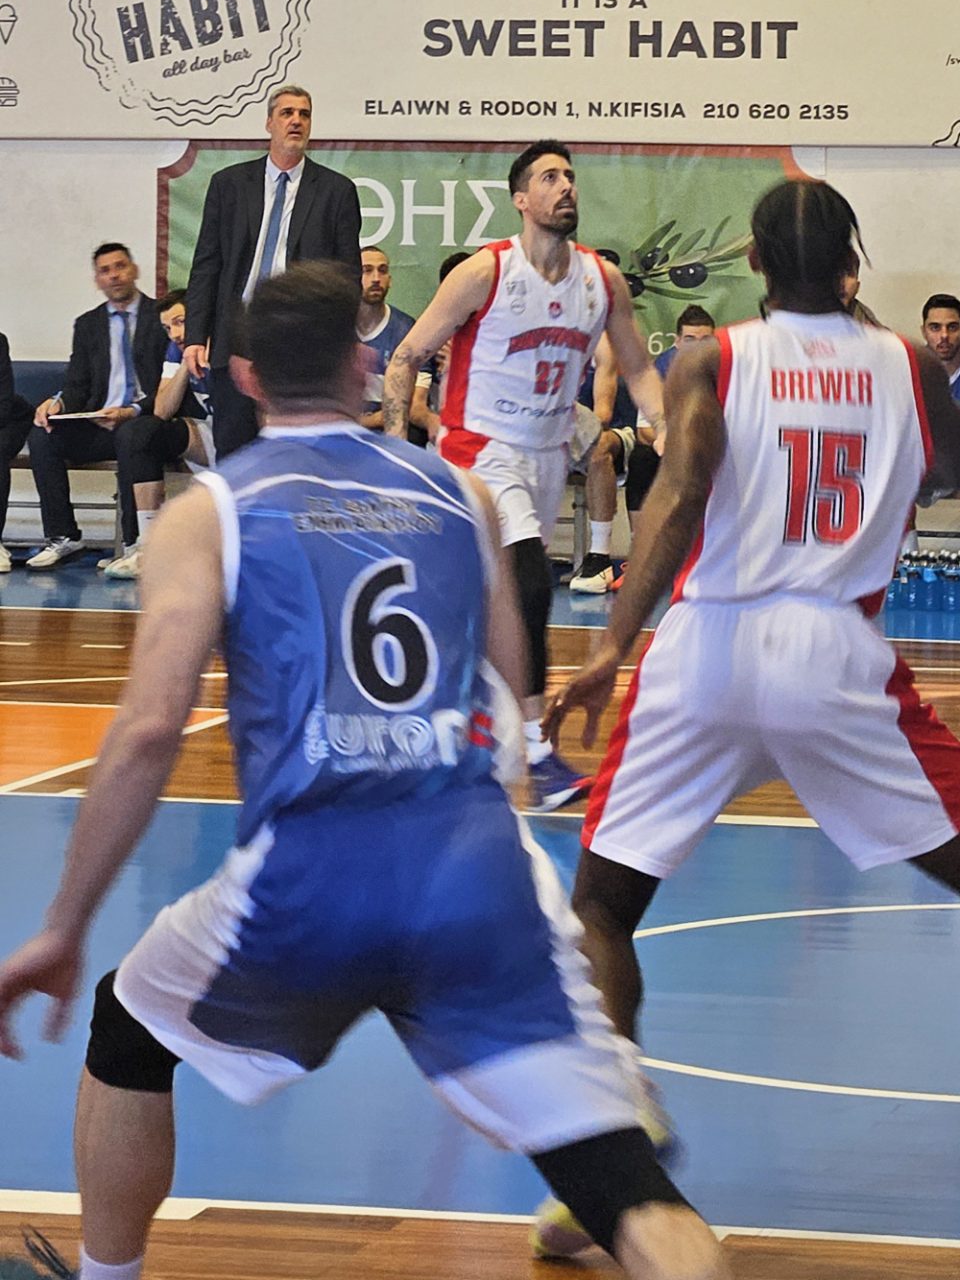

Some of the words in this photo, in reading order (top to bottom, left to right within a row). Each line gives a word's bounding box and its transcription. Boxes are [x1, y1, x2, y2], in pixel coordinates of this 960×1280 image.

[422, 19, 605, 57] SWEET
[629, 20, 798, 59] HABIT
[162, 59, 188, 78] all
[189, 55, 222, 73] day
[223, 48, 253, 64] bar
[364, 100, 450, 116] ELAIWN
[458, 100, 472, 116] &
[480, 100, 557, 117] RODON
[566, 102, 579, 119] 1,
[588, 101, 686, 119] N.KIFISIA
[703, 103, 740, 119] 210
[748, 103, 790, 120] 620
[799, 103, 849, 120] 2135
[771, 367, 873, 407] BREWER
[778, 426, 866, 548] 15
[340, 555, 440, 712] 6
